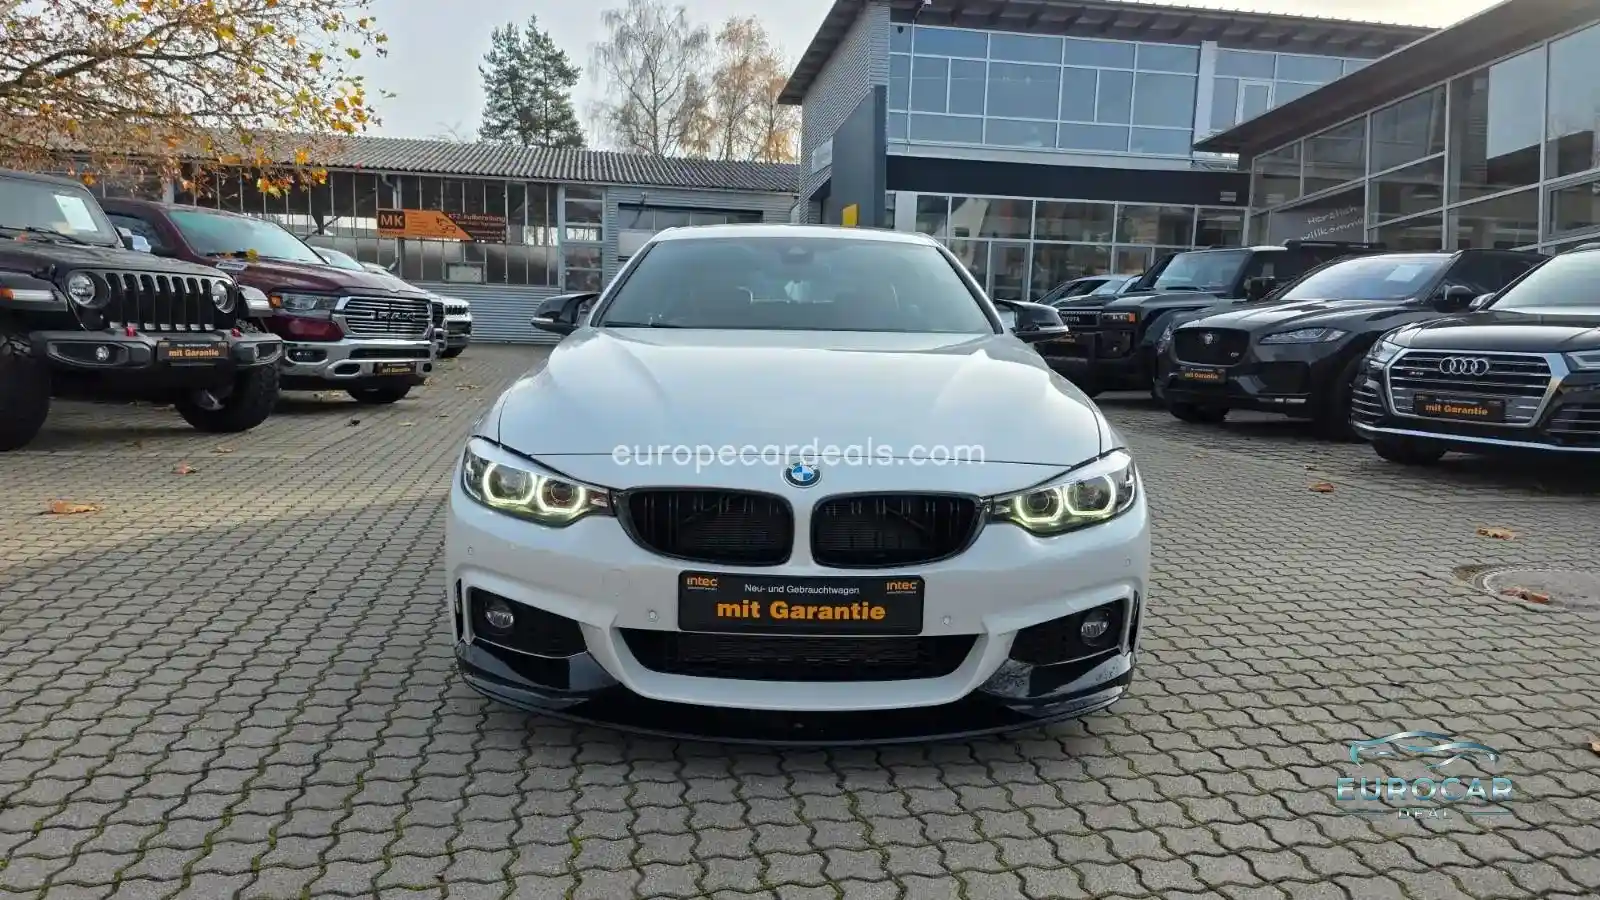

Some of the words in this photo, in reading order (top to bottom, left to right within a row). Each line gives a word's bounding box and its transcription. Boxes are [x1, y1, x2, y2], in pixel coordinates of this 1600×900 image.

[380, 213, 403, 227] MK
[1425, 404, 1441, 412] mit
[1443, 405, 1489, 416] Garantie
[686, 576, 718, 587] intec
[886, 581, 918, 591] intec
[744, 584, 766, 592] Neu-
[768, 585, 785, 593] und
[786, 585, 860, 596] Gebrauchtwagen
[717, 599, 761, 618] mit
[769, 600, 886, 620] Garantie
